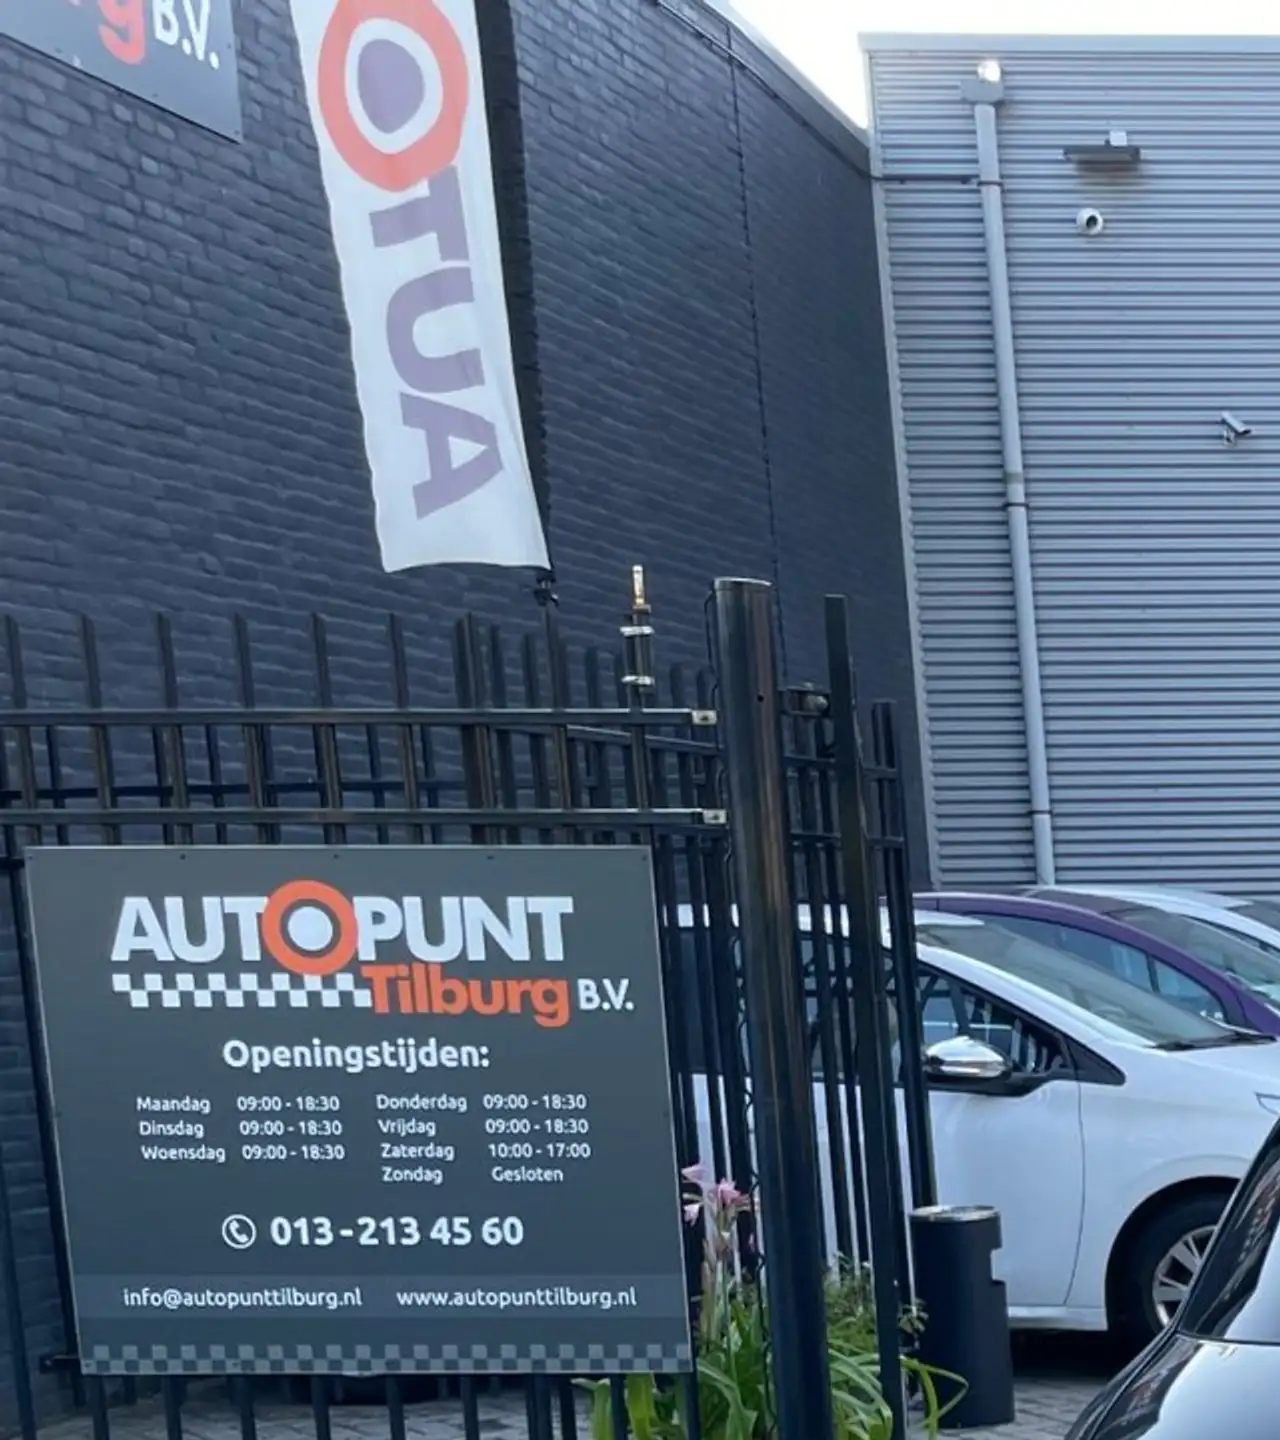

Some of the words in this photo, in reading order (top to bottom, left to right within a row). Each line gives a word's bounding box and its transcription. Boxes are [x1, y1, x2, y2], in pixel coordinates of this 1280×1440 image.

[111, 880, 573, 975] AUTOPUNT
[360, 964, 570, 1027] Tilburg
[578, 978, 634, 1010] B.V.
[223, 1038, 489, 1073] Openingstijden:
[136, 1096, 211, 1114] Maandag
[237, 1096, 282, 1111] 09:00
[297, 1096, 340, 1111] 18:30
[376, 1094, 468, 1112] Donderdag
[483, 1094, 528, 1109] 09:00
[543, 1094, 587, 1109] 18:30
[139, 1120, 204, 1138] Dinsdag
[239, 1120, 284, 1135] 09:00
[299, 1120, 342, 1135] 18:30
[378, 1119, 436, 1136] Vrijdag
[485, 1119, 530, 1134] 09:00
[545, 1119, 588, 1134] 18:30
[141, 1145, 226, 1163] Woensdag
[242, 1145, 287, 1160] 09:00
[301, 1145, 345, 1160] 18:30
[381, 1143, 455, 1161] Zaterdag
[488, 1143, 533, 1158] 10:00
[547, 1143, 591, 1158] 17:00
[382, 1166, 443, 1184] Zondag
[491, 1166, 564, 1182] Gesloten
[429, 1216, 472, 1246] 45
[481, 1216, 524, 1245] 60
[123, 1287, 362, 1310] info@autopunttilburg.nl
[396, 1287, 637, 1310] www.autopunttilburg.nl
